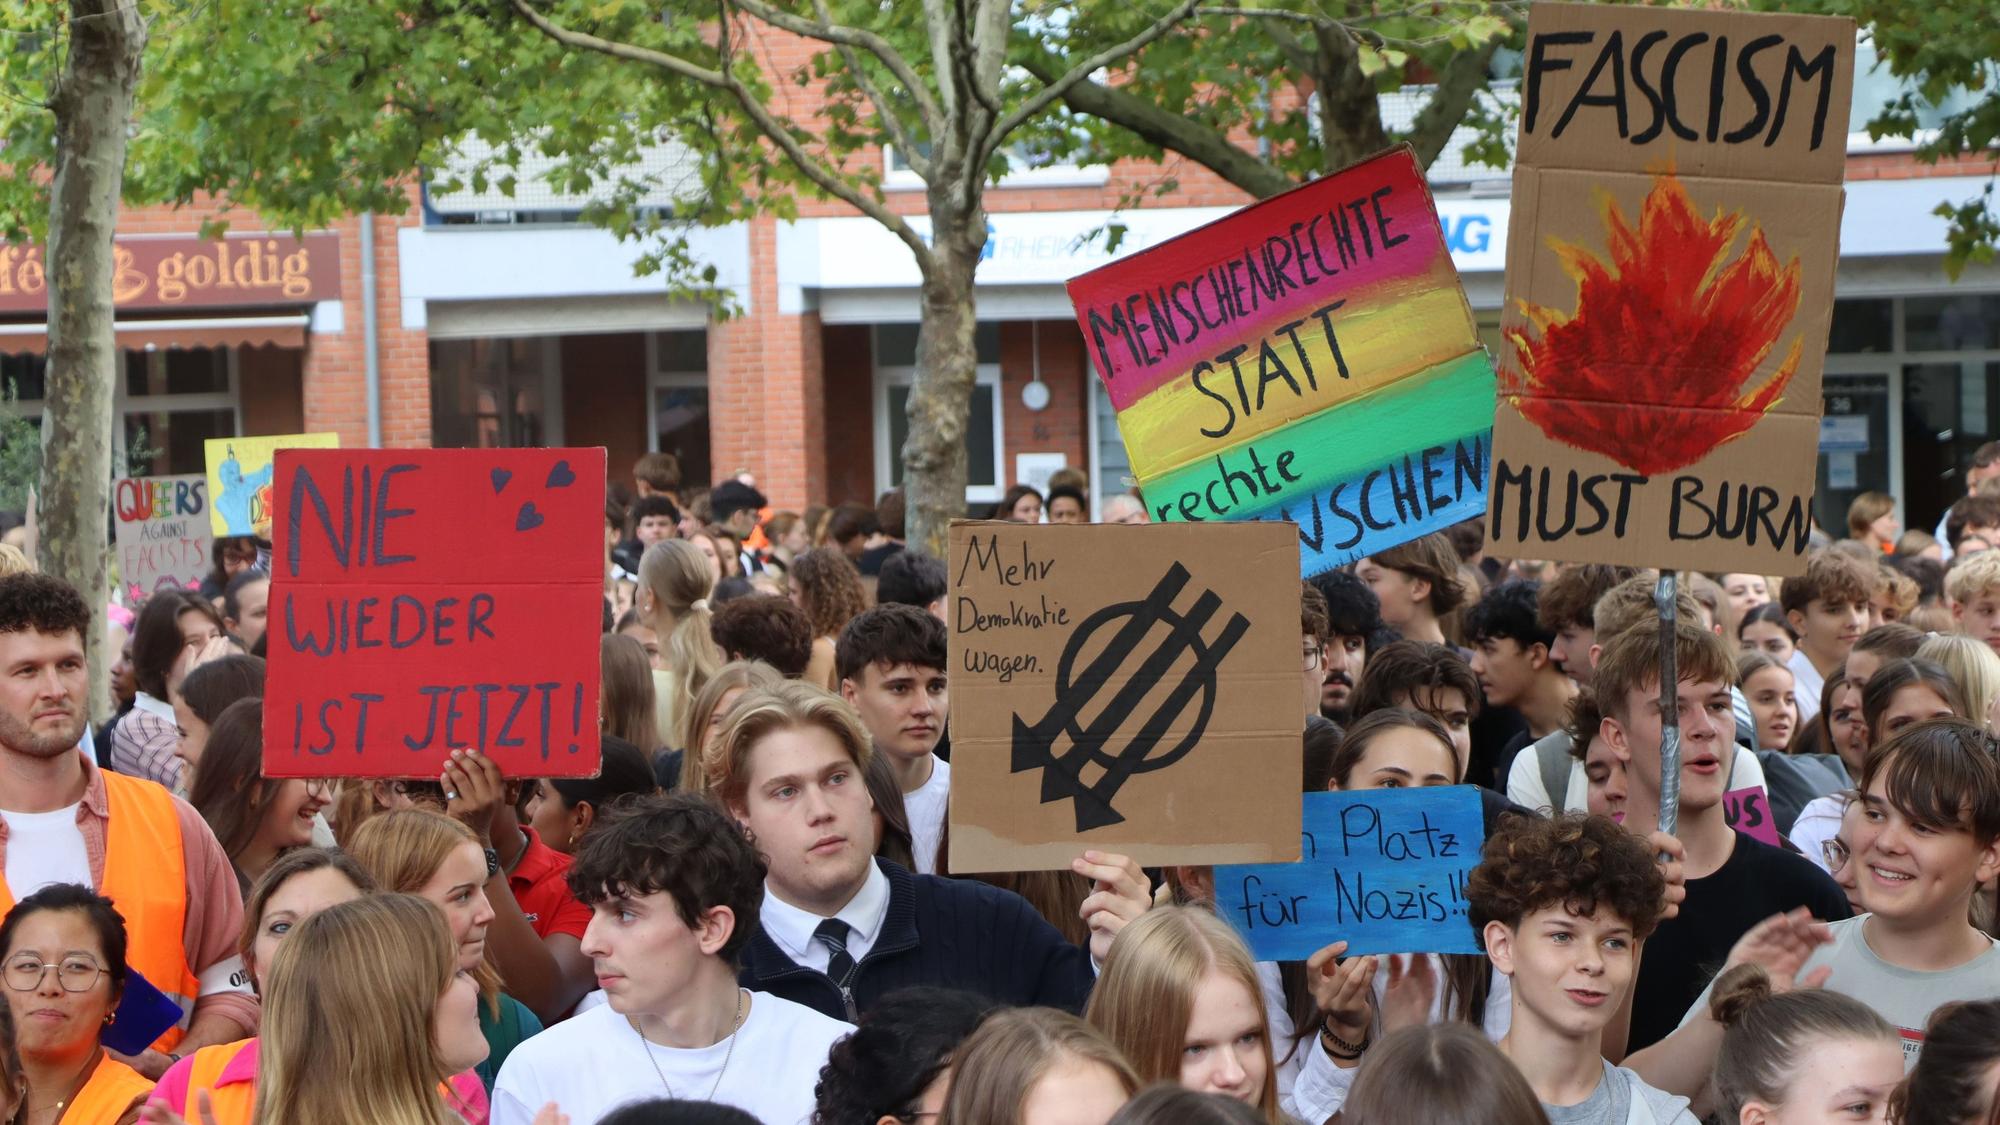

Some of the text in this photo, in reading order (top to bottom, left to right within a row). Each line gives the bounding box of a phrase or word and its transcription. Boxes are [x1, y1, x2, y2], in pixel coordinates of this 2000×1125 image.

[1524, 29, 1837, 152] FASCISM
[157, 240, 313, 303] goldig
[1087, 186, 1409, 379] MENSCHENRECHTE
[1191, 299, 1350, 439] STATT
[116, 479, 204, 522] QUEERS
[287, 464, 421, 577] NIE
[1156, 447, 1304, 523] rechte
[1252, 432, 1484, 555] NSCHEN
[1492, 459, 1814, 555] MUST BURN
[140, 520, 188, 541] AGAINST
[957, 534, 1055, 587] Mehr
[284, 592, 496, 657] WIEDER
[292, 682, 584, 761] IST JETZT!
[1340, 803, 1459, 861] Platz
[1237, 875, 1307, 929] für
